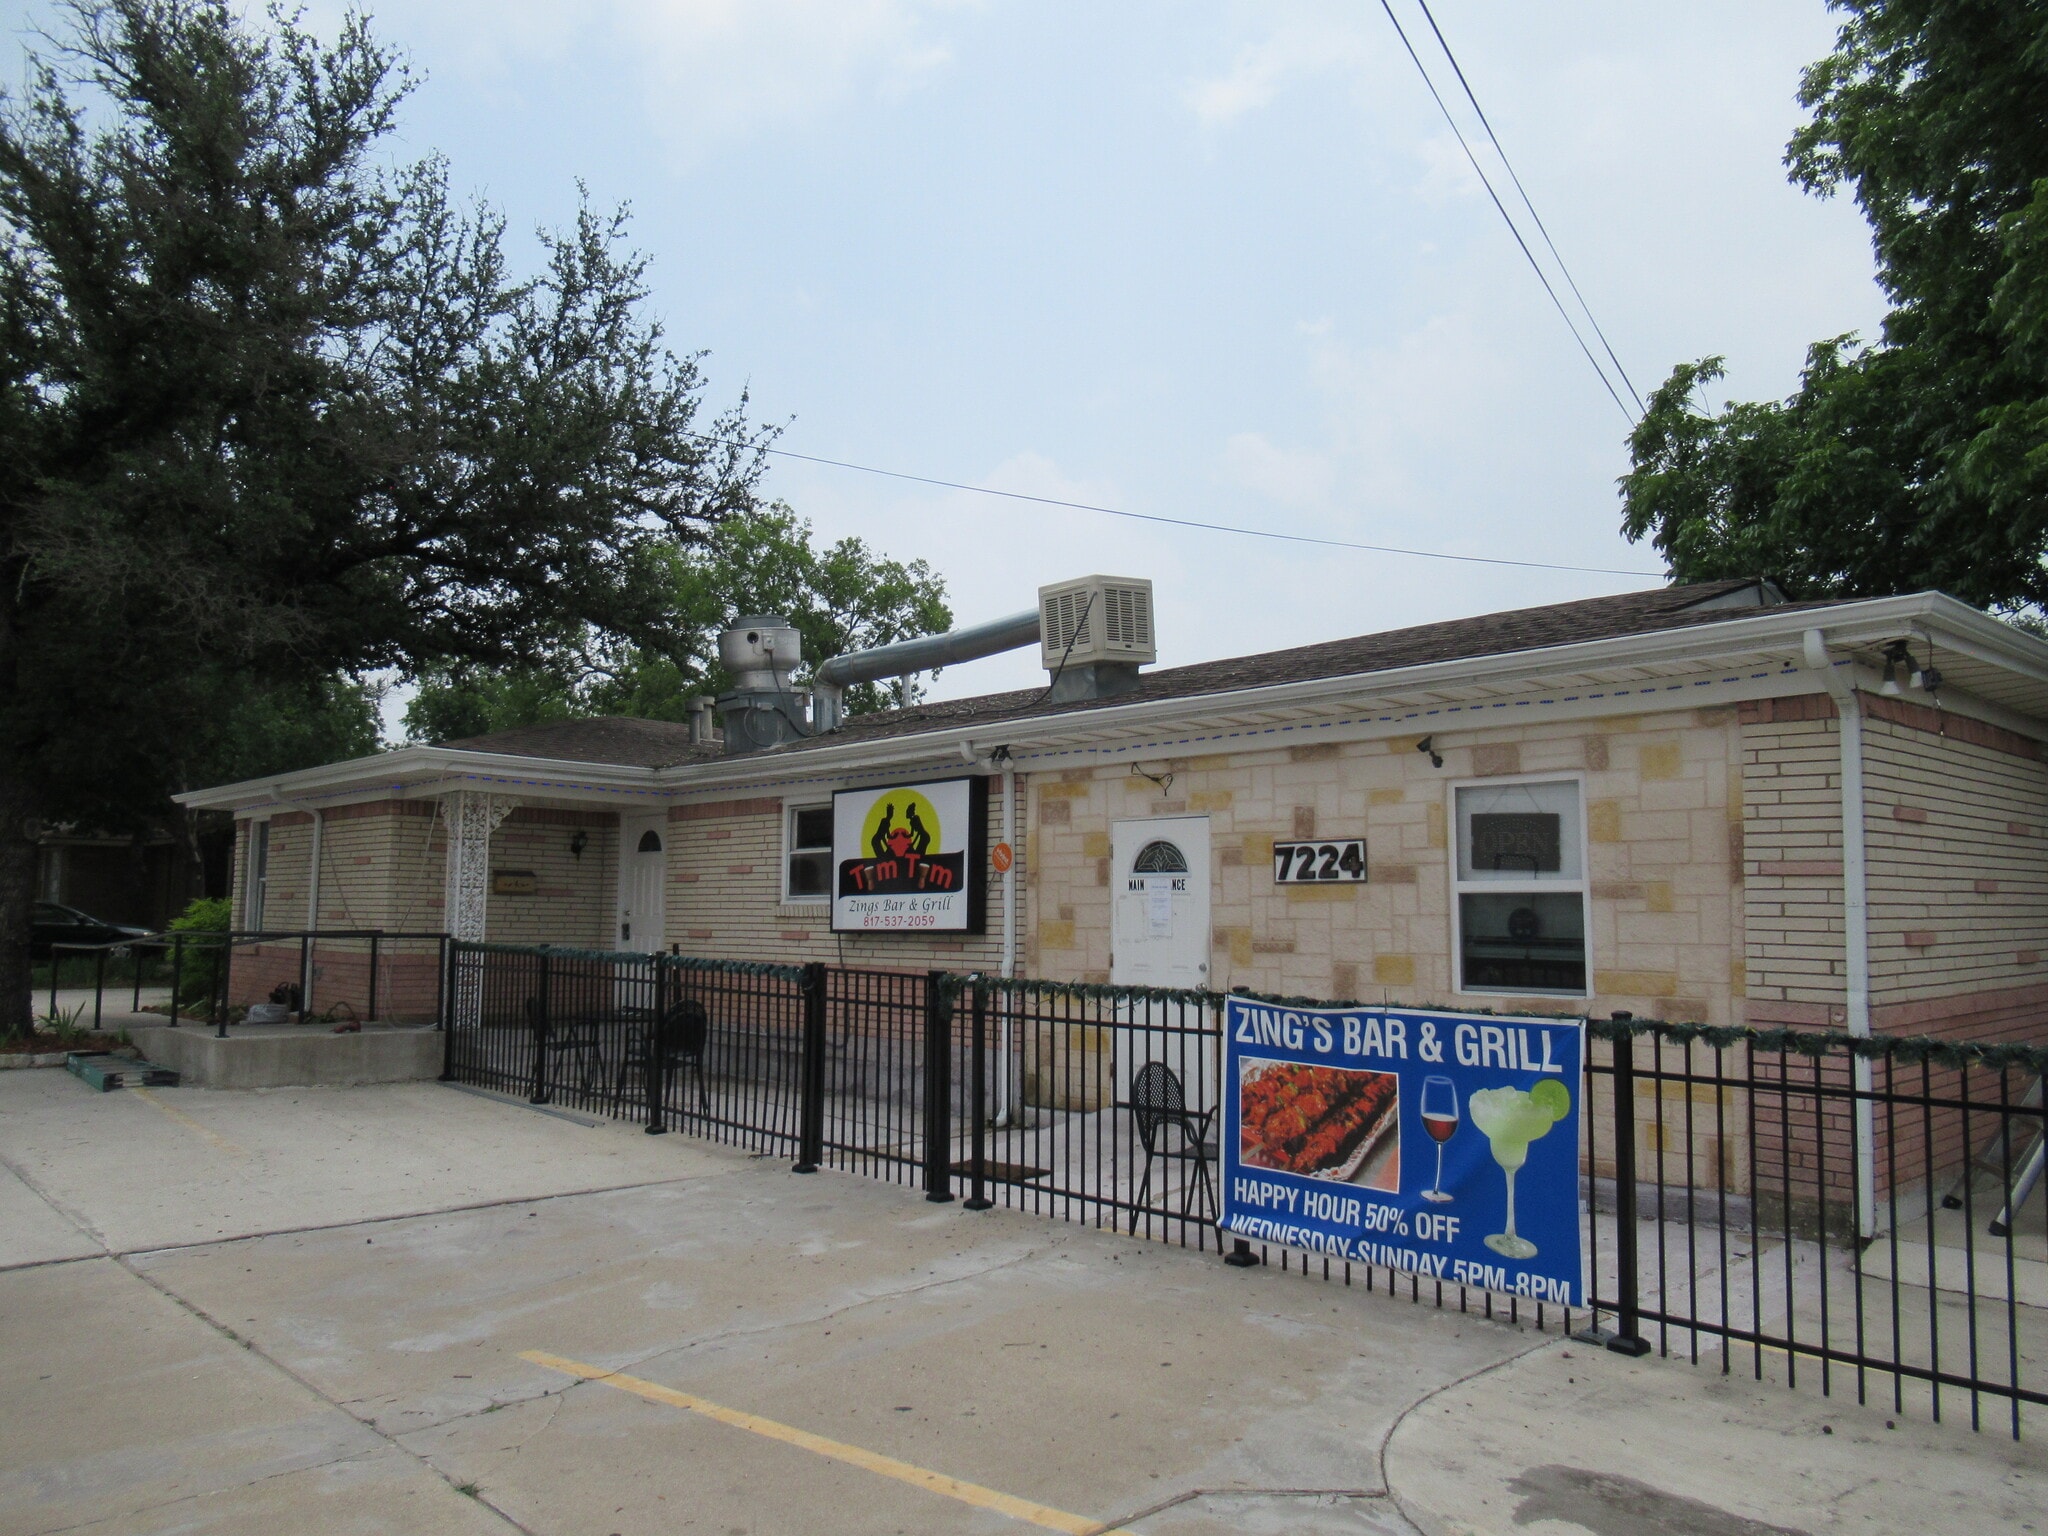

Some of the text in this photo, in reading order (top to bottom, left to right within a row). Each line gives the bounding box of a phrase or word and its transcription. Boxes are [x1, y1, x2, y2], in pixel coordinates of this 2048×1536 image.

[1274, 843, 1364, 880] 7224
[1128, 879, 1145, 891] MAIN
[849, 895, 954, 916] Zings Bar & Grill
[863, 916, 935, 927] 817-537-2059
[1235, 1006, 1563, 1073] ZING'S BAR & GRILL
[1234, 1177, 1460, 1243] HAPPY HOUR 50% OFF
[1453, 1259, 1570, 1306] 5PM-8PM
